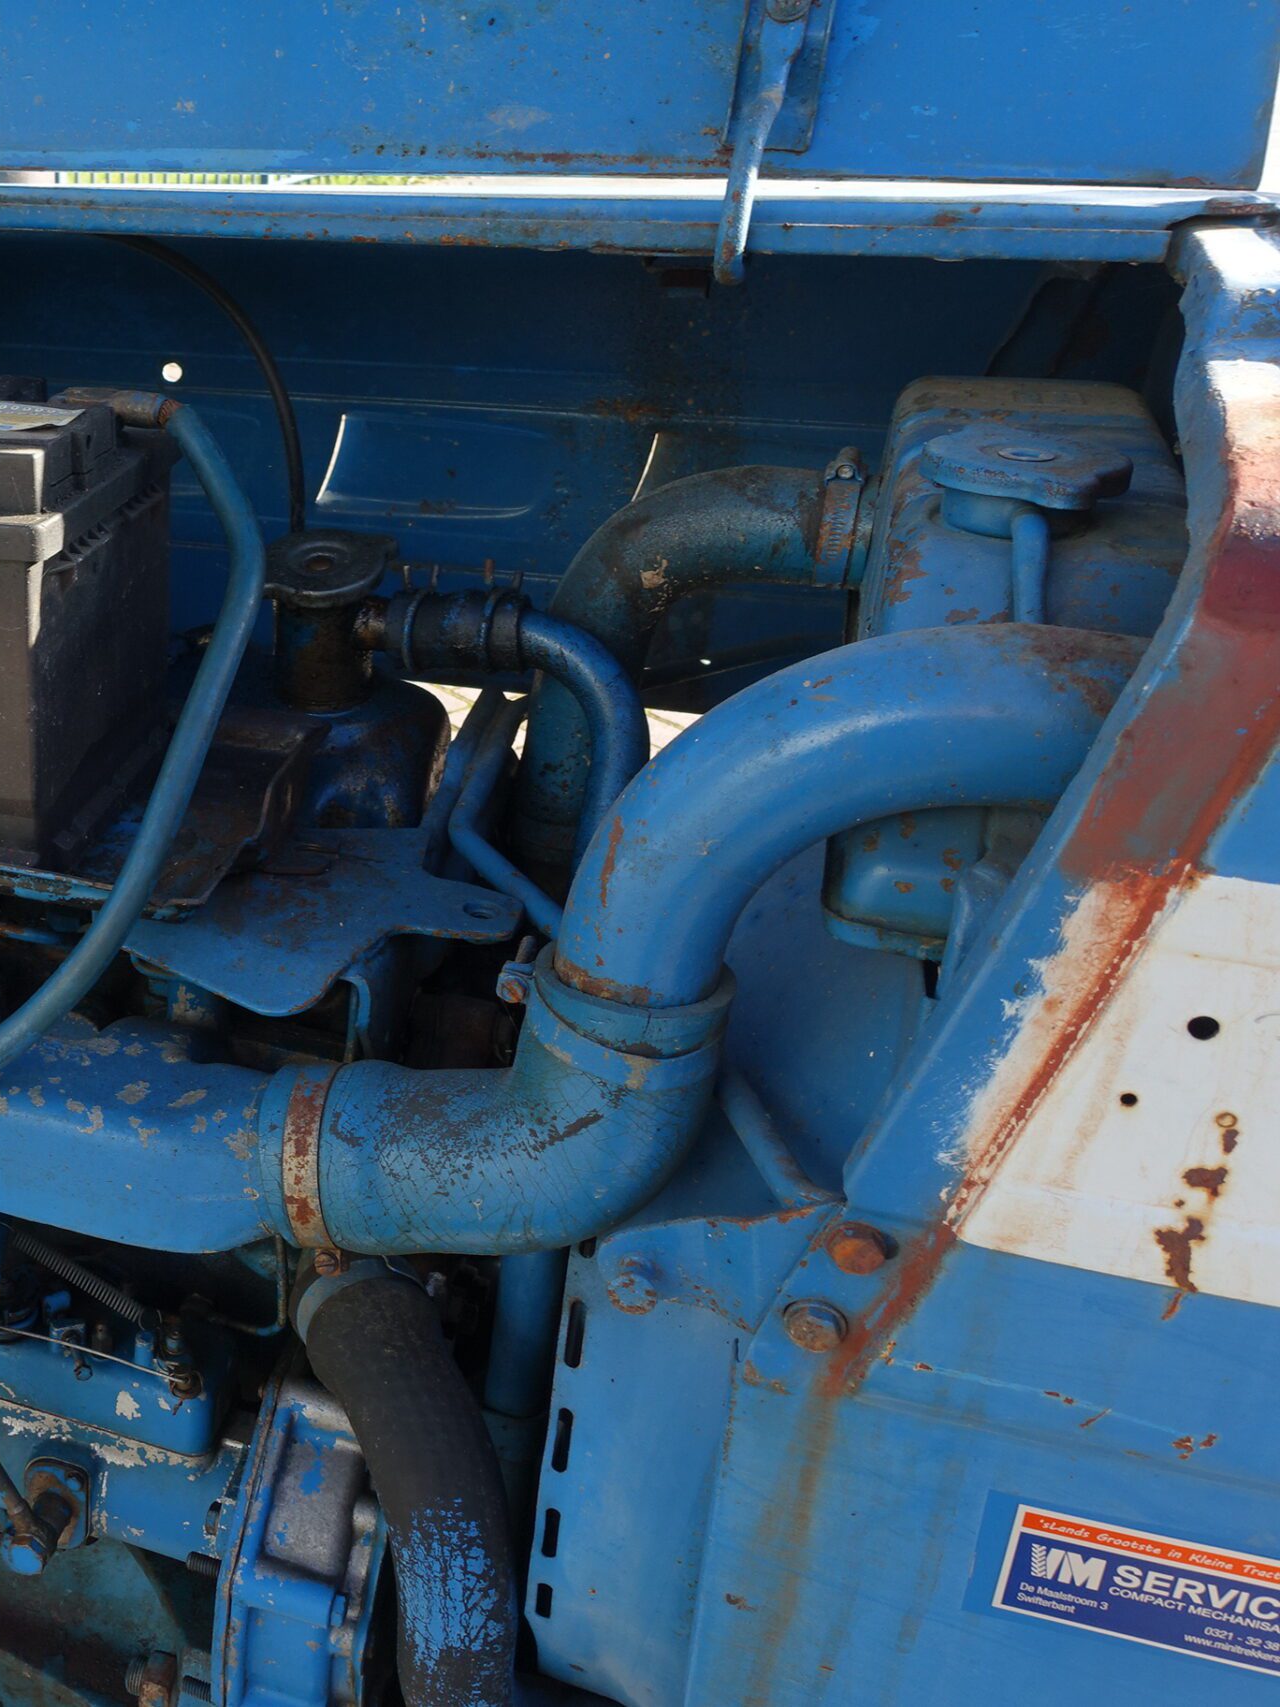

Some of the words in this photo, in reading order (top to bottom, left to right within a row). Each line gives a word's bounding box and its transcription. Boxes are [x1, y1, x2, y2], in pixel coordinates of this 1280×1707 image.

[1096, 1533, 1162, 1555] Grootste
[1167, 1549, 1183, 1560] in
[1188, 1553, 1235, 1571] Kleine
[1017, 1592, 1077, 1614] Swifterbant
[1020, 1582, 1036, 1593] De
[1037, 1586, 1099, 1609] Maalstroom
[1099, 1601, 1110, 1611] 3
[1108, 1586, 1187, 1612] COMPACT
[1187, 1605, 1280, 1635] MECHANISA
[1204, 1626, 1234, 1641] 0321
[1245, 1636, 1263, 1648] 32
